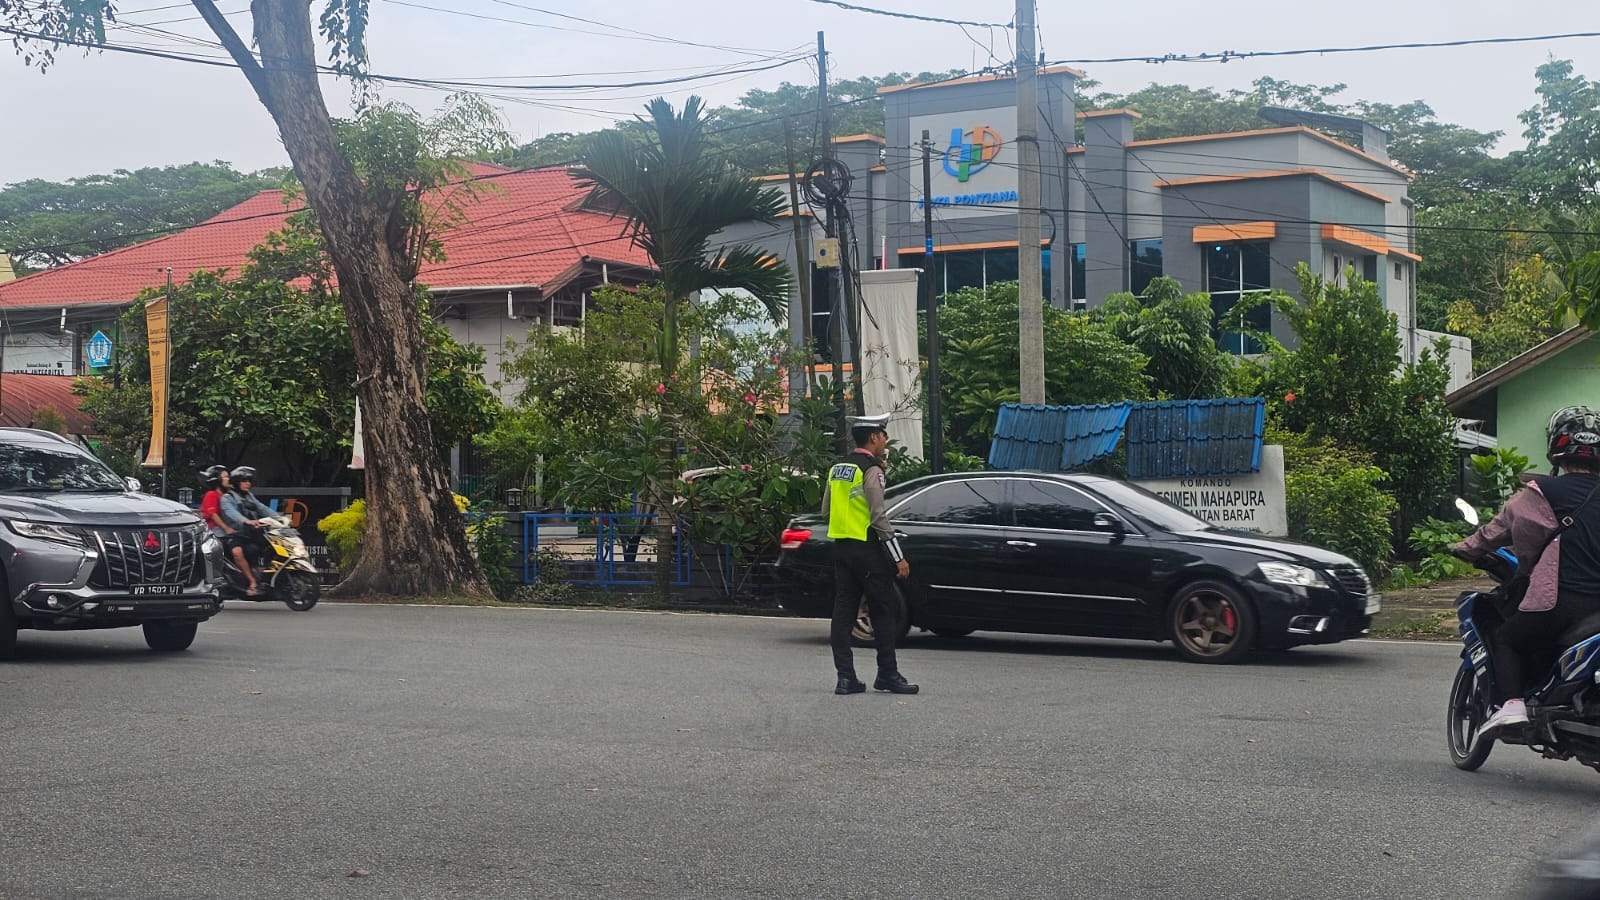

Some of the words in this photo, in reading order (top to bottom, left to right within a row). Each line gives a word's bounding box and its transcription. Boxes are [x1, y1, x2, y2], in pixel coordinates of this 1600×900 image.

[954, 191, 1018, 205] PONTIANA
[1180, 478, 1232, 488] KOMANDO
[1201, 490, 1266, 507] MAHAPURA
[1223, 509, 1256, 521] BARAT
